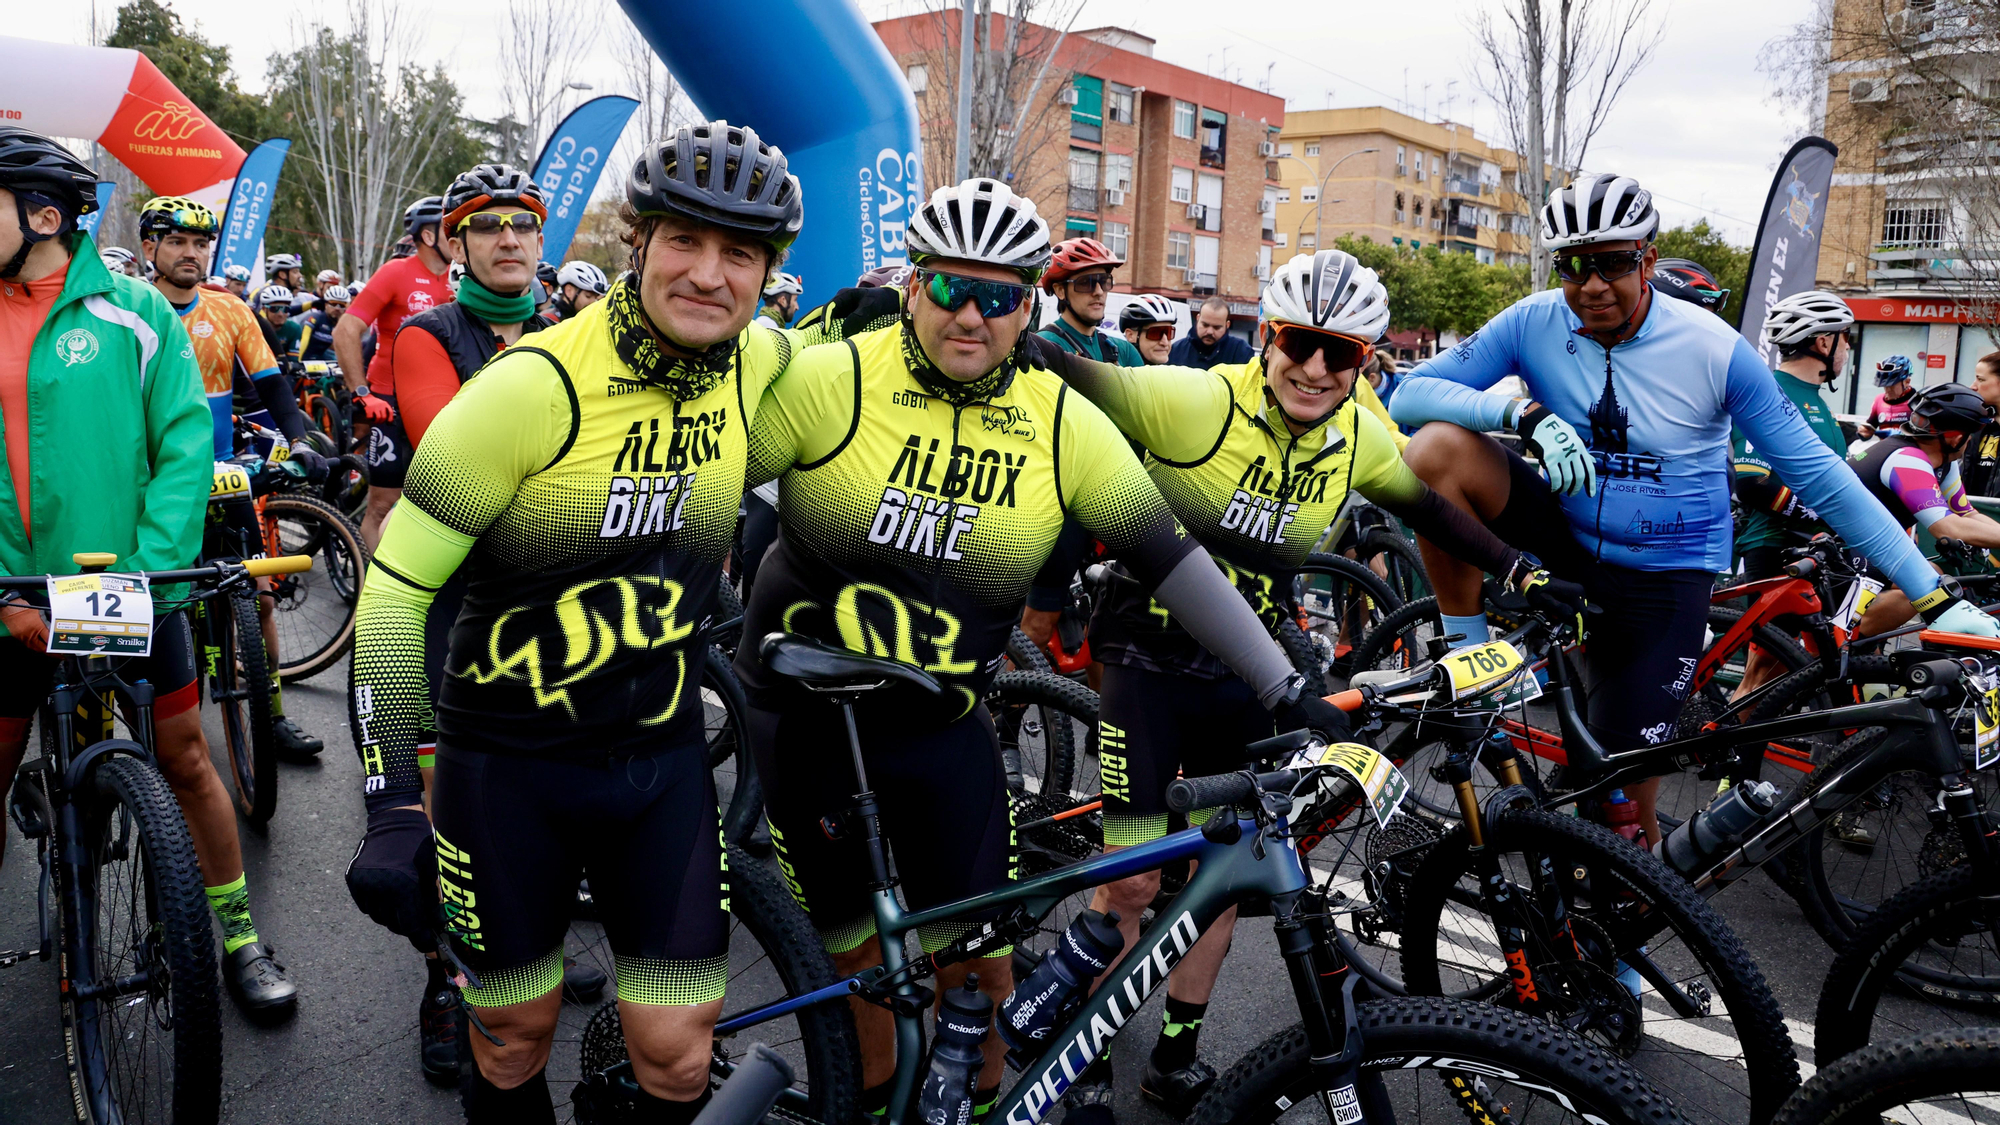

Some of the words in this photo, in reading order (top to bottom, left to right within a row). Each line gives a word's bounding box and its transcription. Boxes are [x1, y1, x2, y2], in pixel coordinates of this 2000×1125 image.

[129, 143, 173, 156] FUERZAS
[176, 146, 222, 159] ARMADAS
[539, 135, 576, 208] CABE
[244, 181, 267, 240] Ciclos
[556, 146, 599, 219] Ciclos
[905, 152, 920, 227] Cic
[222, 177, 253, 271] CABELLO
[859, 167, 876, 272] CiclosCABE
[1772, 237, 1789, 271] EL
[1904, 304, 1997, 319] MAPF
[613, 408, 727, 472] ALBOX
[1545, 419, 1577, 459] FOX
[887, 434, 1027, 508] ALBOX
[1612, 484, 1637, 493] JOSÉ
[1639, 486, 1667, 495] RIVAS
[600, 473, 698, 539] BIKE
[866, 486, 980, 561] BIKE
[1219, 488, 1300, 544] BIKE
[86, 592, 122, 617] 12
[117, 638, 145, 647] Smilke
[1457, 647, 1508, 679] 766
[1099, 720, 1131, 803] ALBOX
[1504, 948, 1539, 1004] FOX
[1006, 910, 1200, 1125] SPECIALIZED
[1330, 1088, 1356, 1107] ROCK
[1336, 1106, 1361, 1123] SHOX
[1451, 1076, 1496, 1125] XXIS
